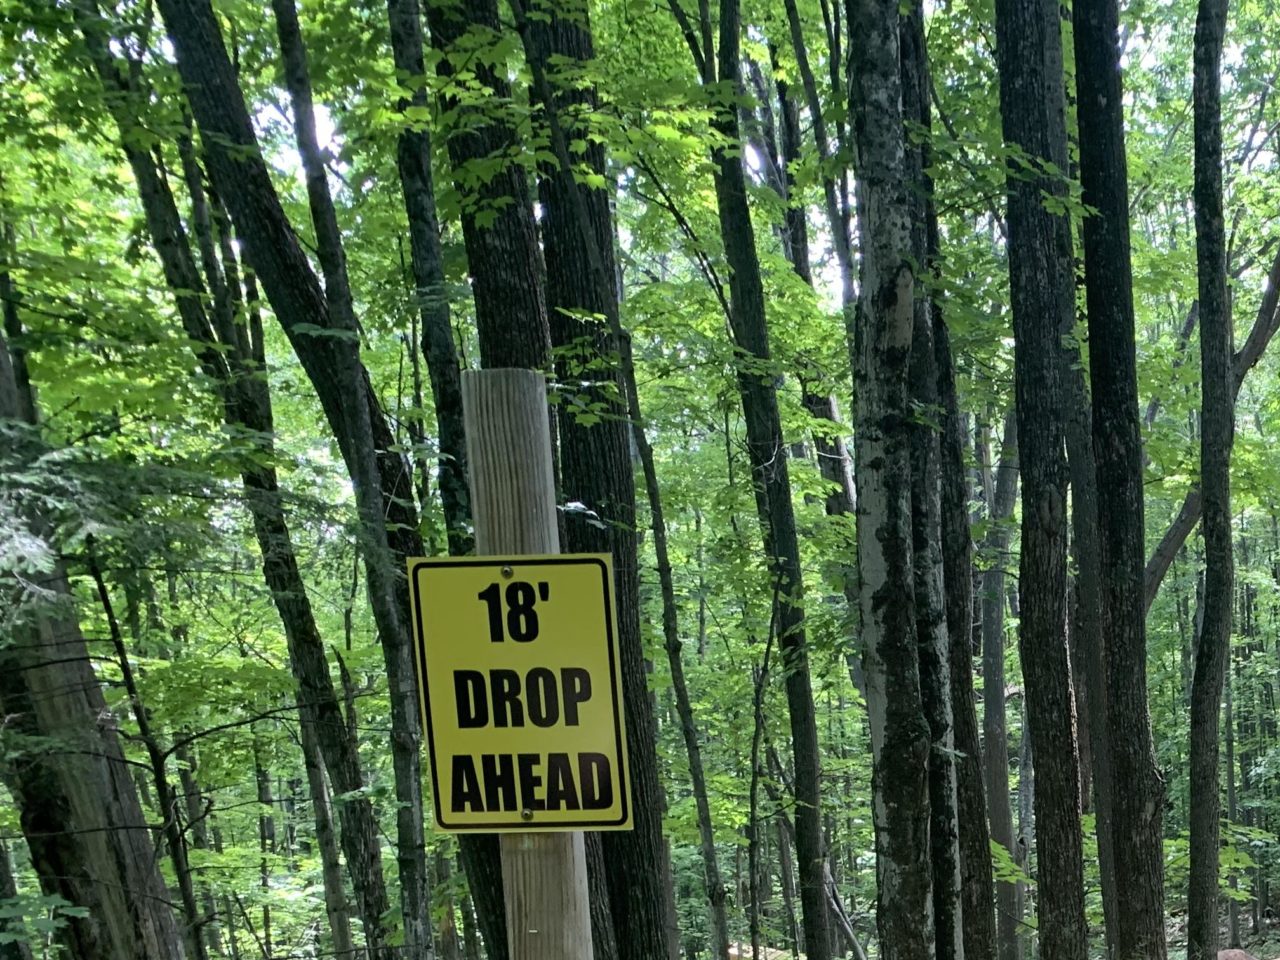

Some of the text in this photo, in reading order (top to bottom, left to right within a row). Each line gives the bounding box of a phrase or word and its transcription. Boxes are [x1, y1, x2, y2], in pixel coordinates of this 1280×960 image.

[478, 582, 549, 642] 18'
[453, 667, 592, 728] DROP
[452, 752, 613, 812] AHEAD
